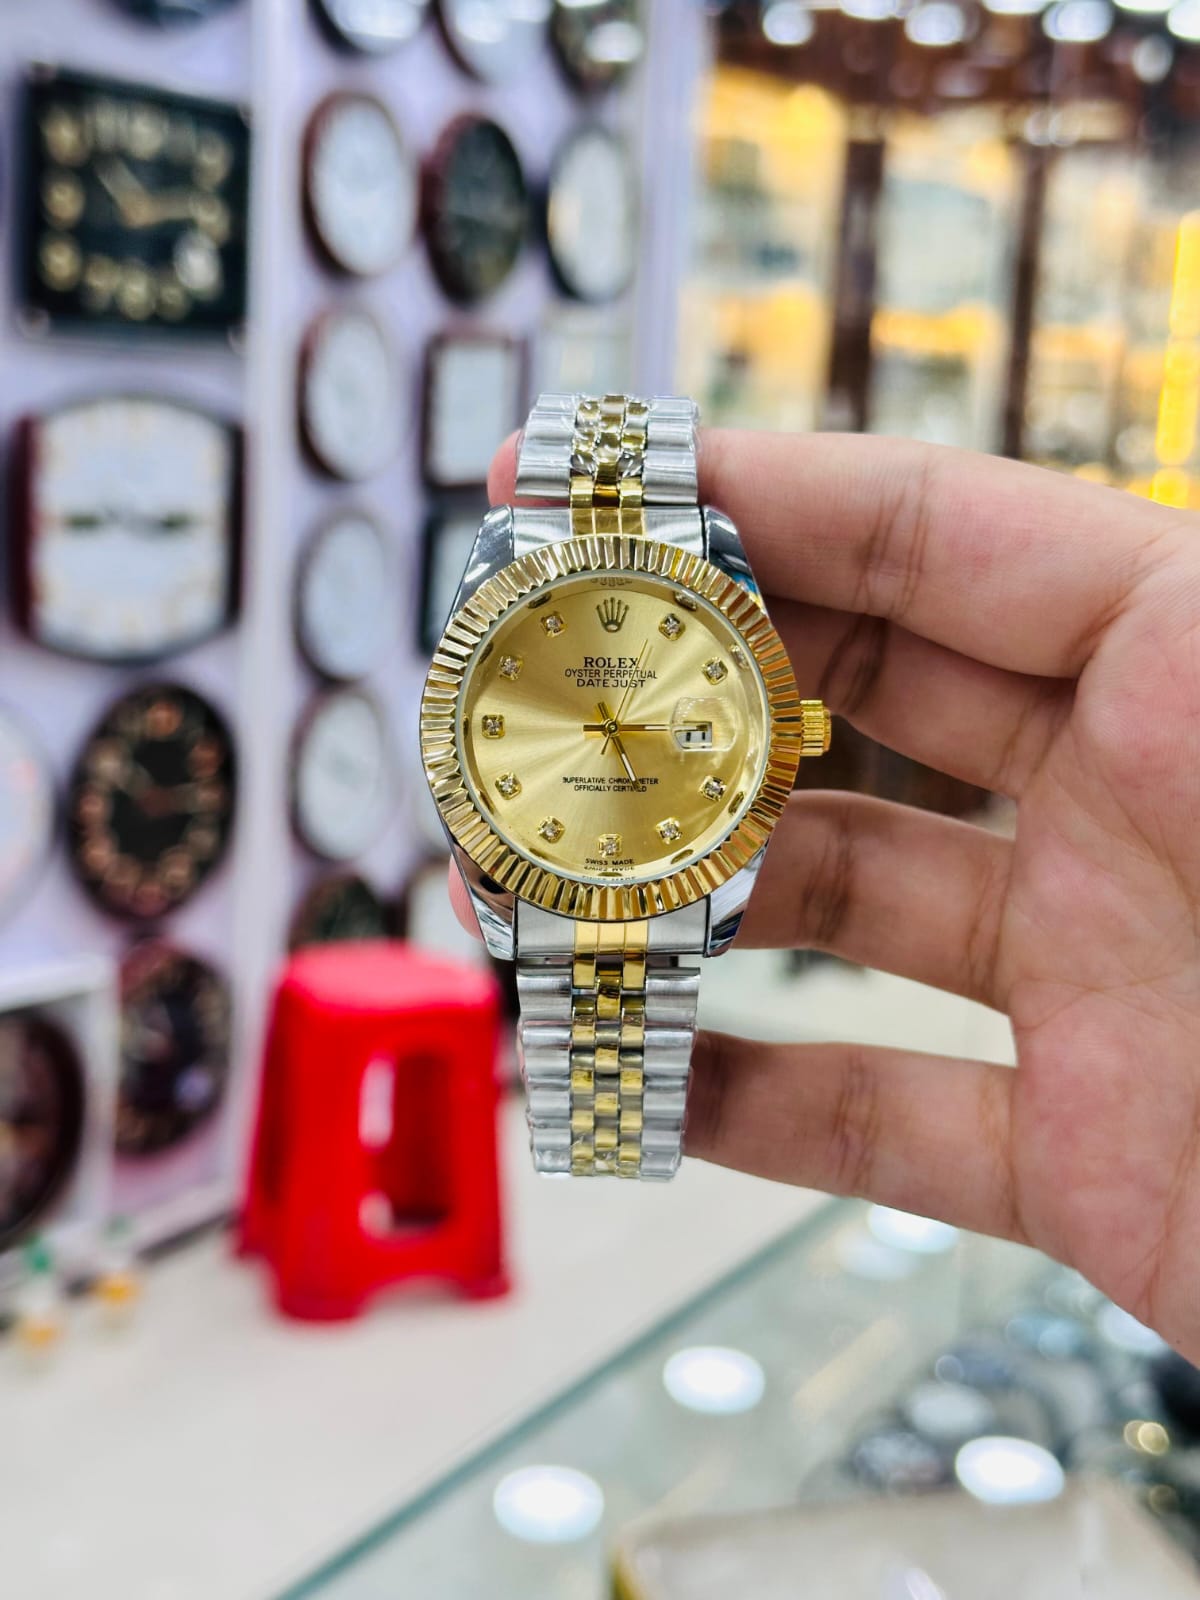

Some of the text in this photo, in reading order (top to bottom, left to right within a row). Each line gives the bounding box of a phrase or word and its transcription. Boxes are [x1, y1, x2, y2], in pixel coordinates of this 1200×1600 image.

[583, 656, 640, 669] ROLEX
[564, 668, 601, 678] OYSTER
[562, 776, 606, 784] SUPERLATIVE
[585, 858, 608, 866] SWISS
